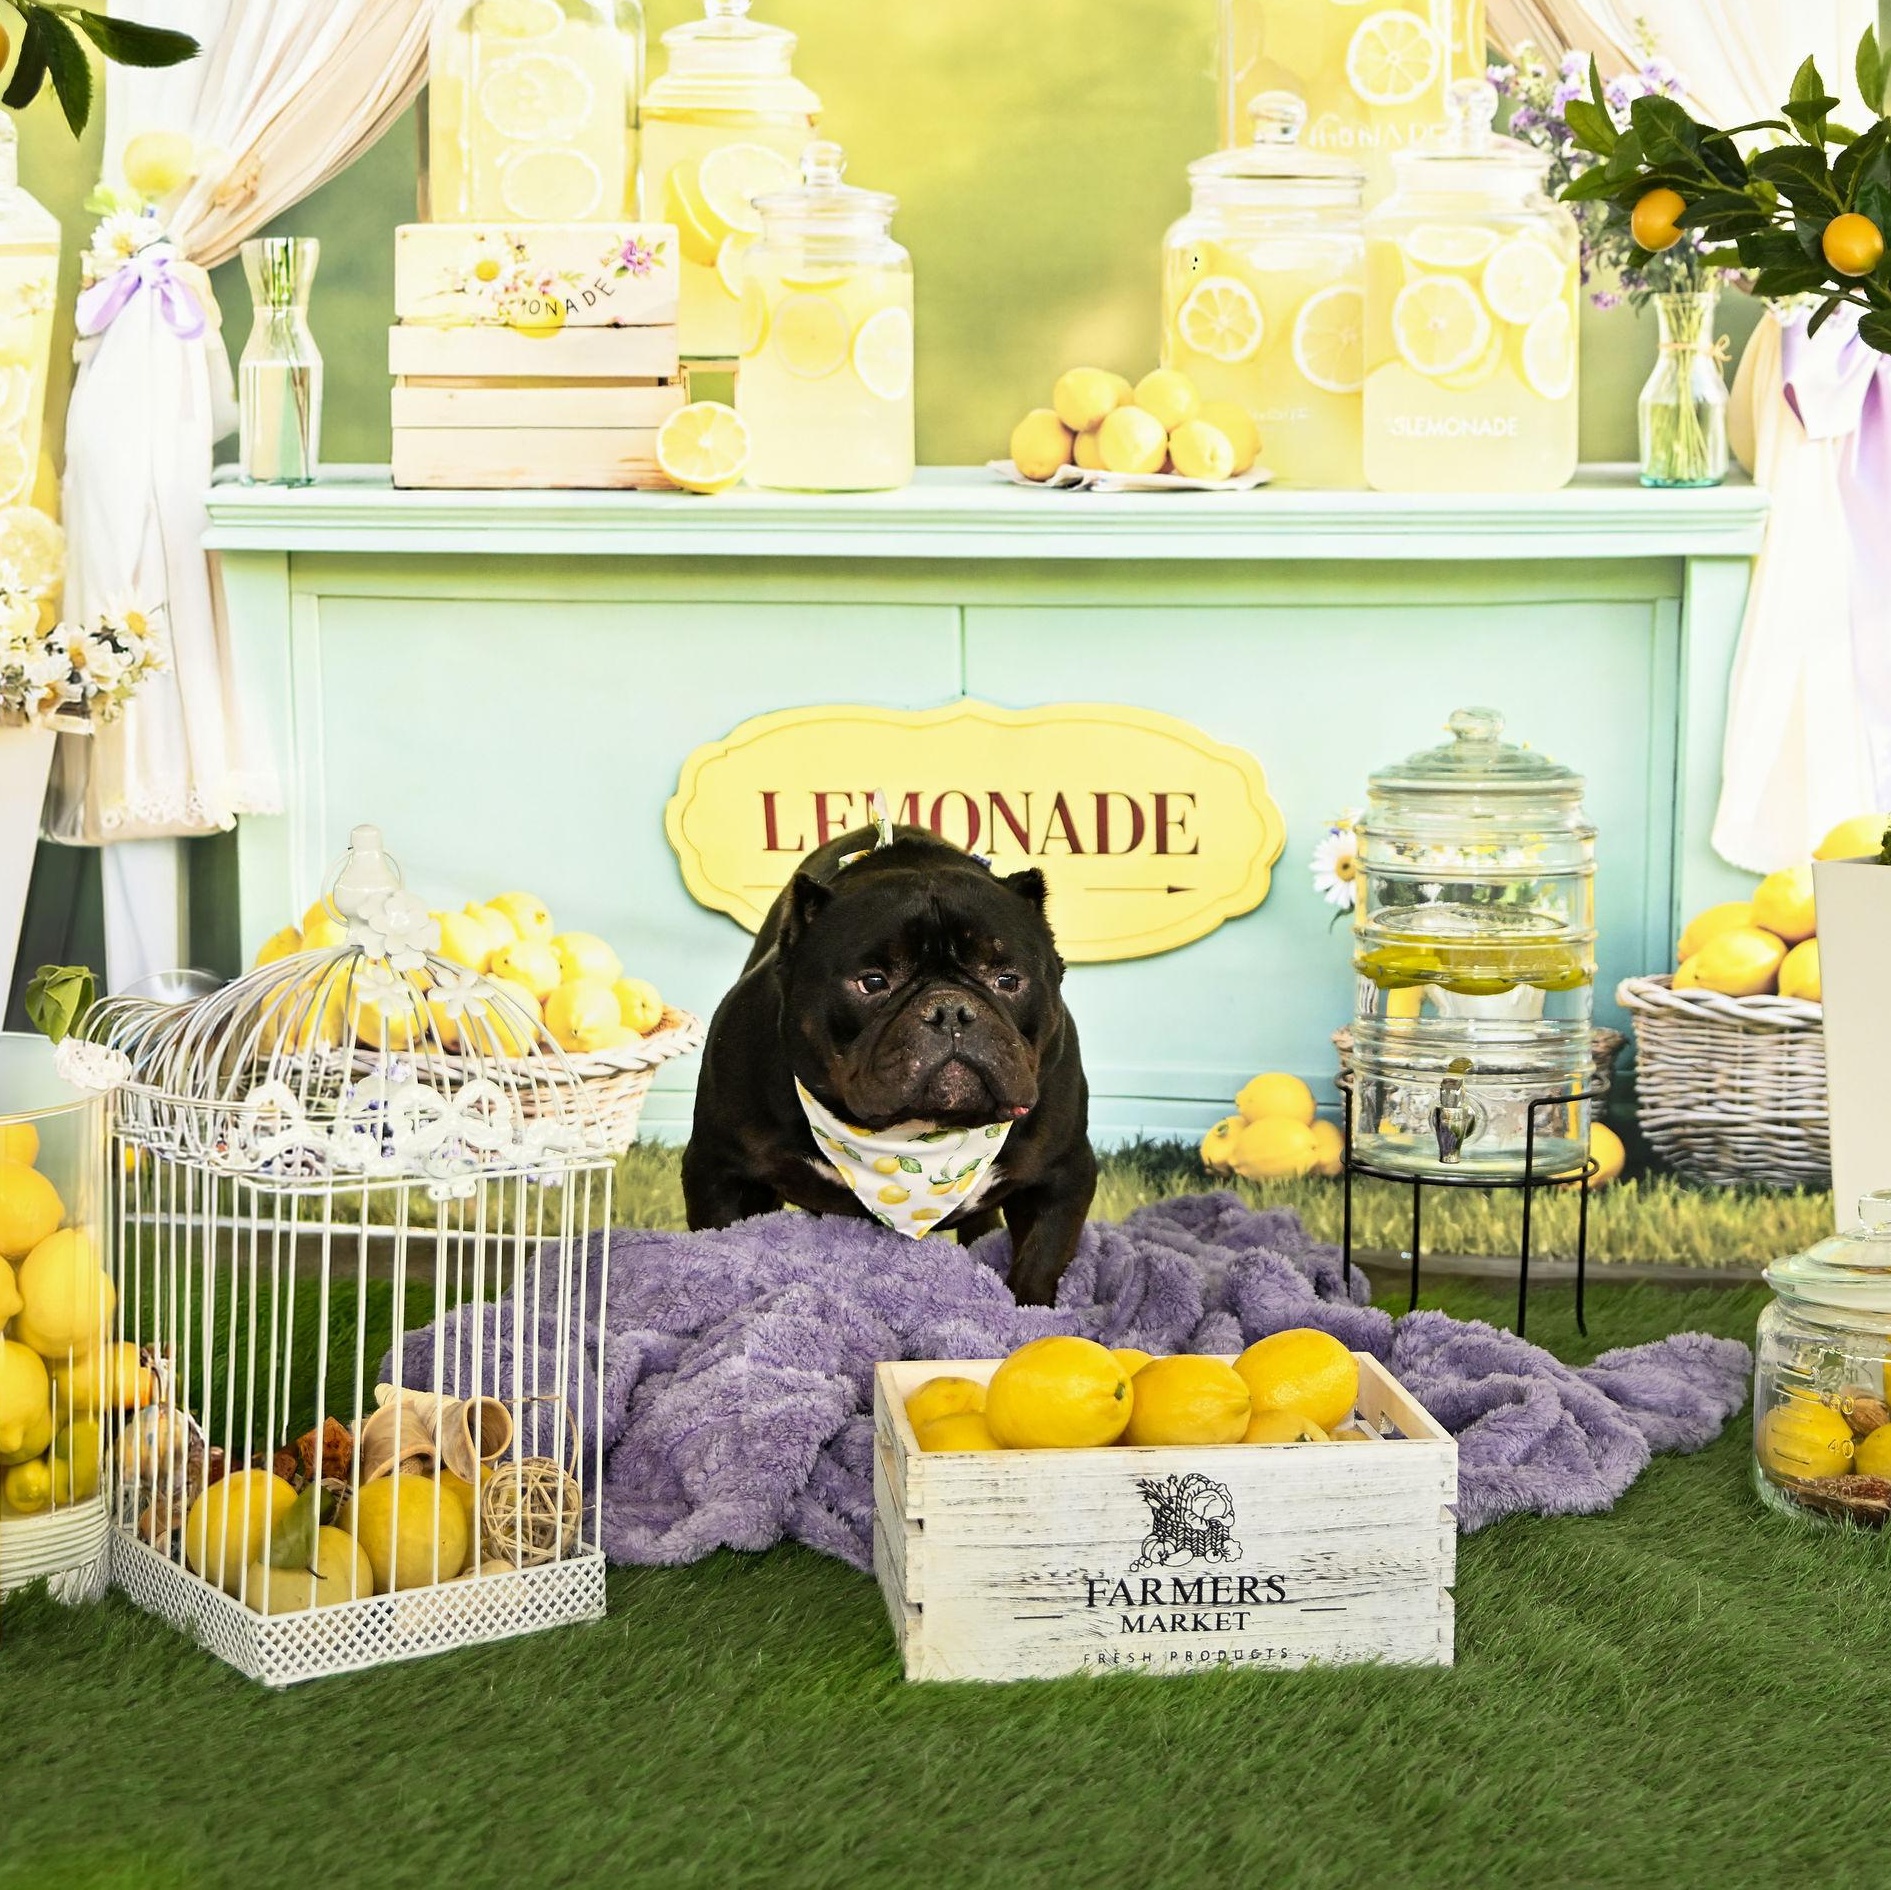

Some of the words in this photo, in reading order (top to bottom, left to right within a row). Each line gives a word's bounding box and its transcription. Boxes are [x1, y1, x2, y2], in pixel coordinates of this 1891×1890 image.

[521, 277, 616, 316] ONADE
[1085, 1574, 1287, 1608] FARMERS
[1120, 1611, 1251, 1634] MARKET
[1083, 1651, 1152, 1665] FRESH
[1170, 1647, 1289, 1663] PRODUCTS
